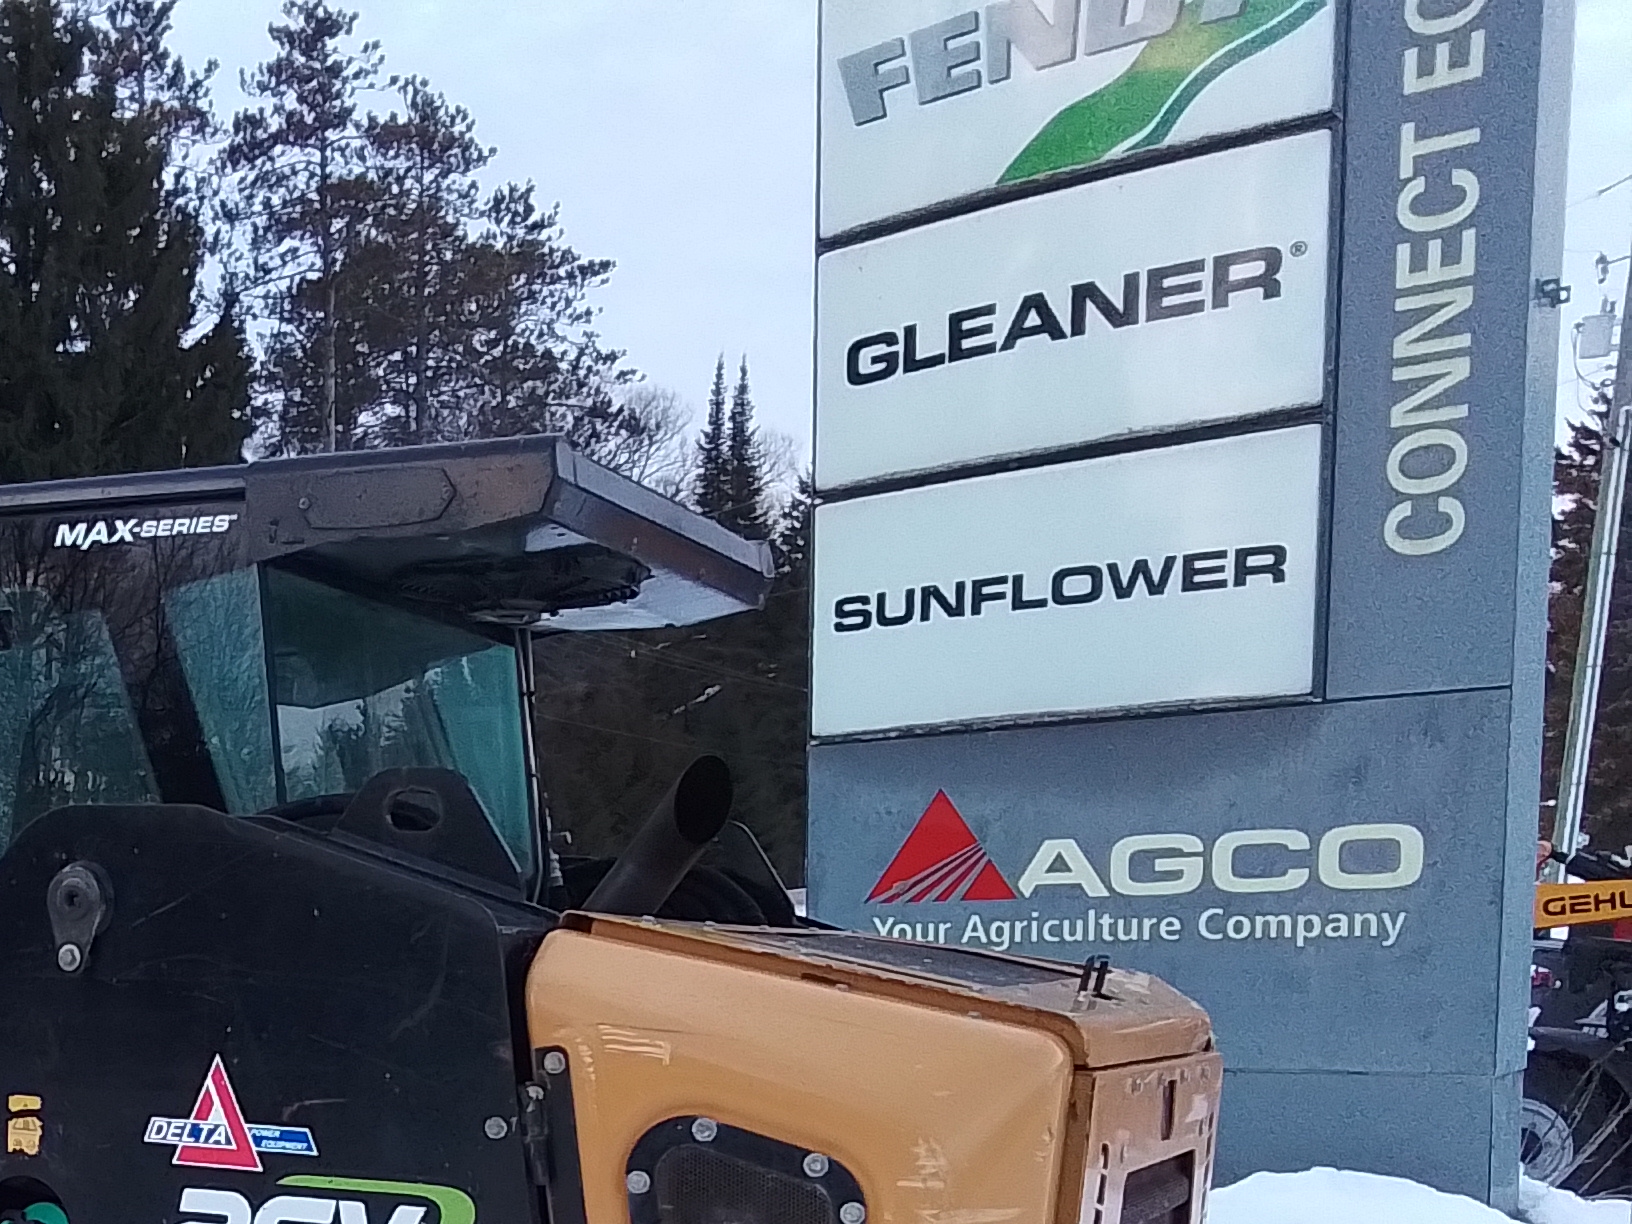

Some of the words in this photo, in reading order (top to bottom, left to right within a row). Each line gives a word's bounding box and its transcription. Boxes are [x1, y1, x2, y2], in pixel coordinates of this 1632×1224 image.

[845, 244, 1285, 388] GLEANER
[1383, 121, 1482, 556] CONNECT
[833, 544, 1288, 633] SUNFLOWER
[1017, 823, 1425, 899] AGCO
[872, 915, 952, 944] Your
[961, 908, 1181, 951] Agriculture
[1197, 907, 1408, 947] Company
[149, 1120, 228, 1146] DELTA
[249, 1128, 281, 1139] POWER
